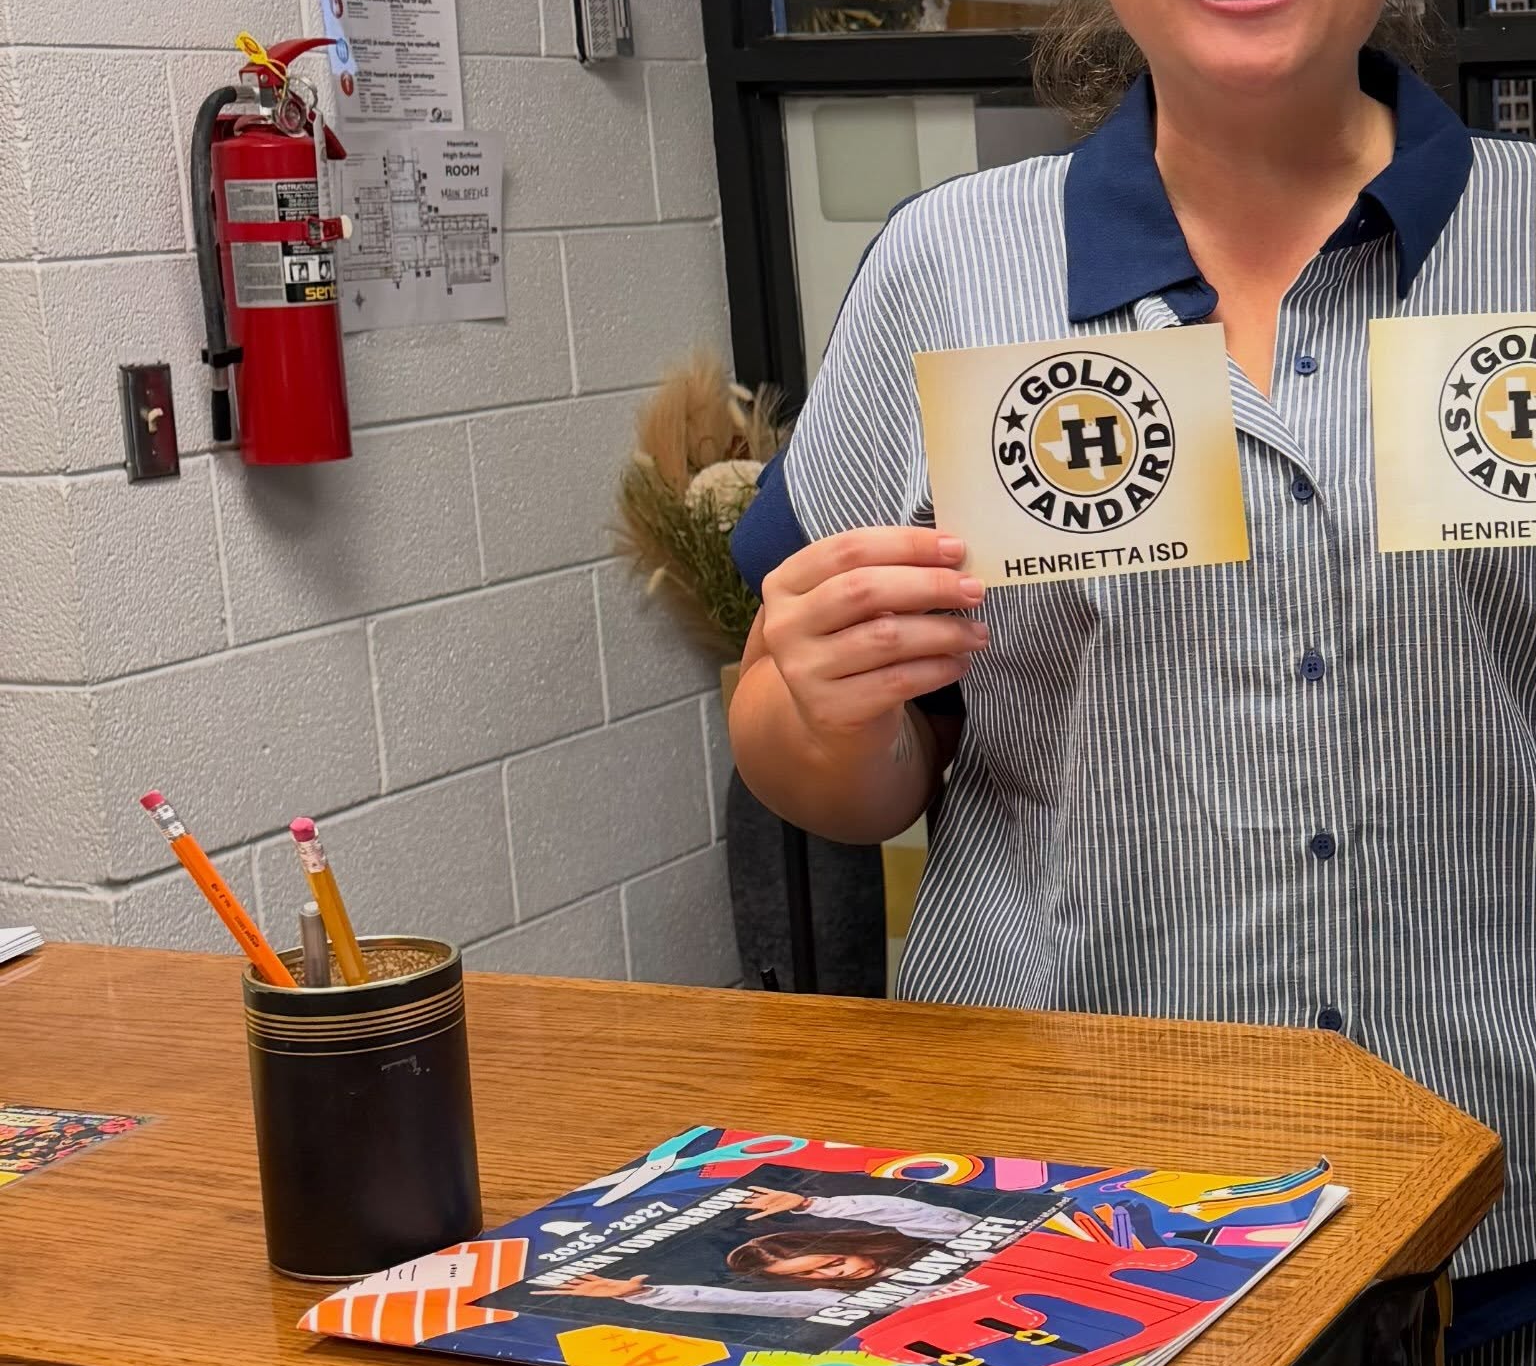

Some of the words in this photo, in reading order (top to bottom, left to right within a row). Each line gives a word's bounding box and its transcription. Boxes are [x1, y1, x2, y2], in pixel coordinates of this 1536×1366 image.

[445, 165, 480, 176] ROOM
[1020, 360, 1132, 405] GOLD
[1061, 415, 1123, 469] H
[999, 423, 1170, 529] STANDARD
[1004, 546, 1144, 577] HENRIETTA
[1149, 541, 1189, 562] ISD
[526, 1253, 623, 1286] WHEN
[602, 1187, 755, 1254] TOMORROW
[538, 1201, 678, 1262] 2026-2027
[846, 1280, 916, 1309] MY
[890, 1249, 971, 1285] DAY
[945, 1216, 1028, 1252] OFF!
